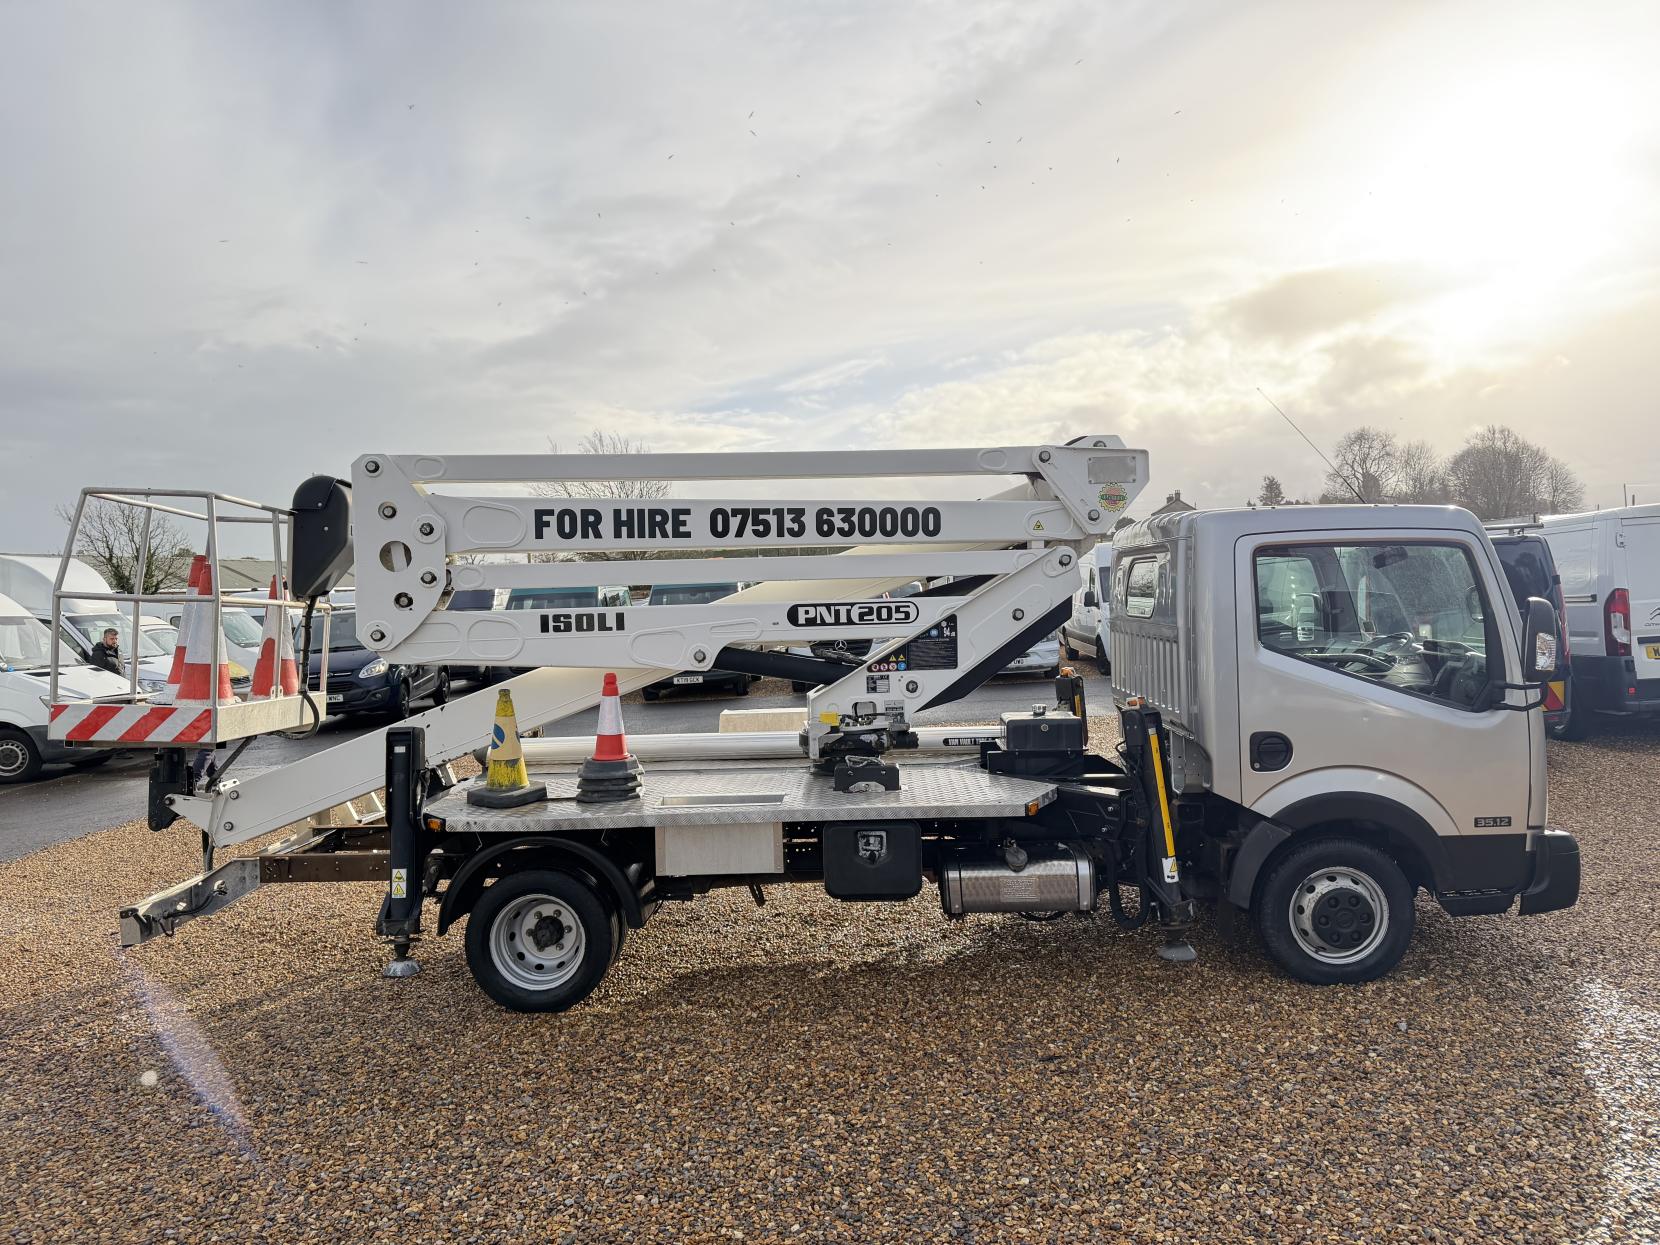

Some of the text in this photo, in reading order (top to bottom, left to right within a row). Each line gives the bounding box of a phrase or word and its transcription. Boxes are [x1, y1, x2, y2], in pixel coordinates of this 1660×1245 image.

[534, 506, 941, 540] FOR HIRE 07513 630000
[540, 612, 625, 633] ISOLI
[1477, 818, 1509, 826] 35.12
